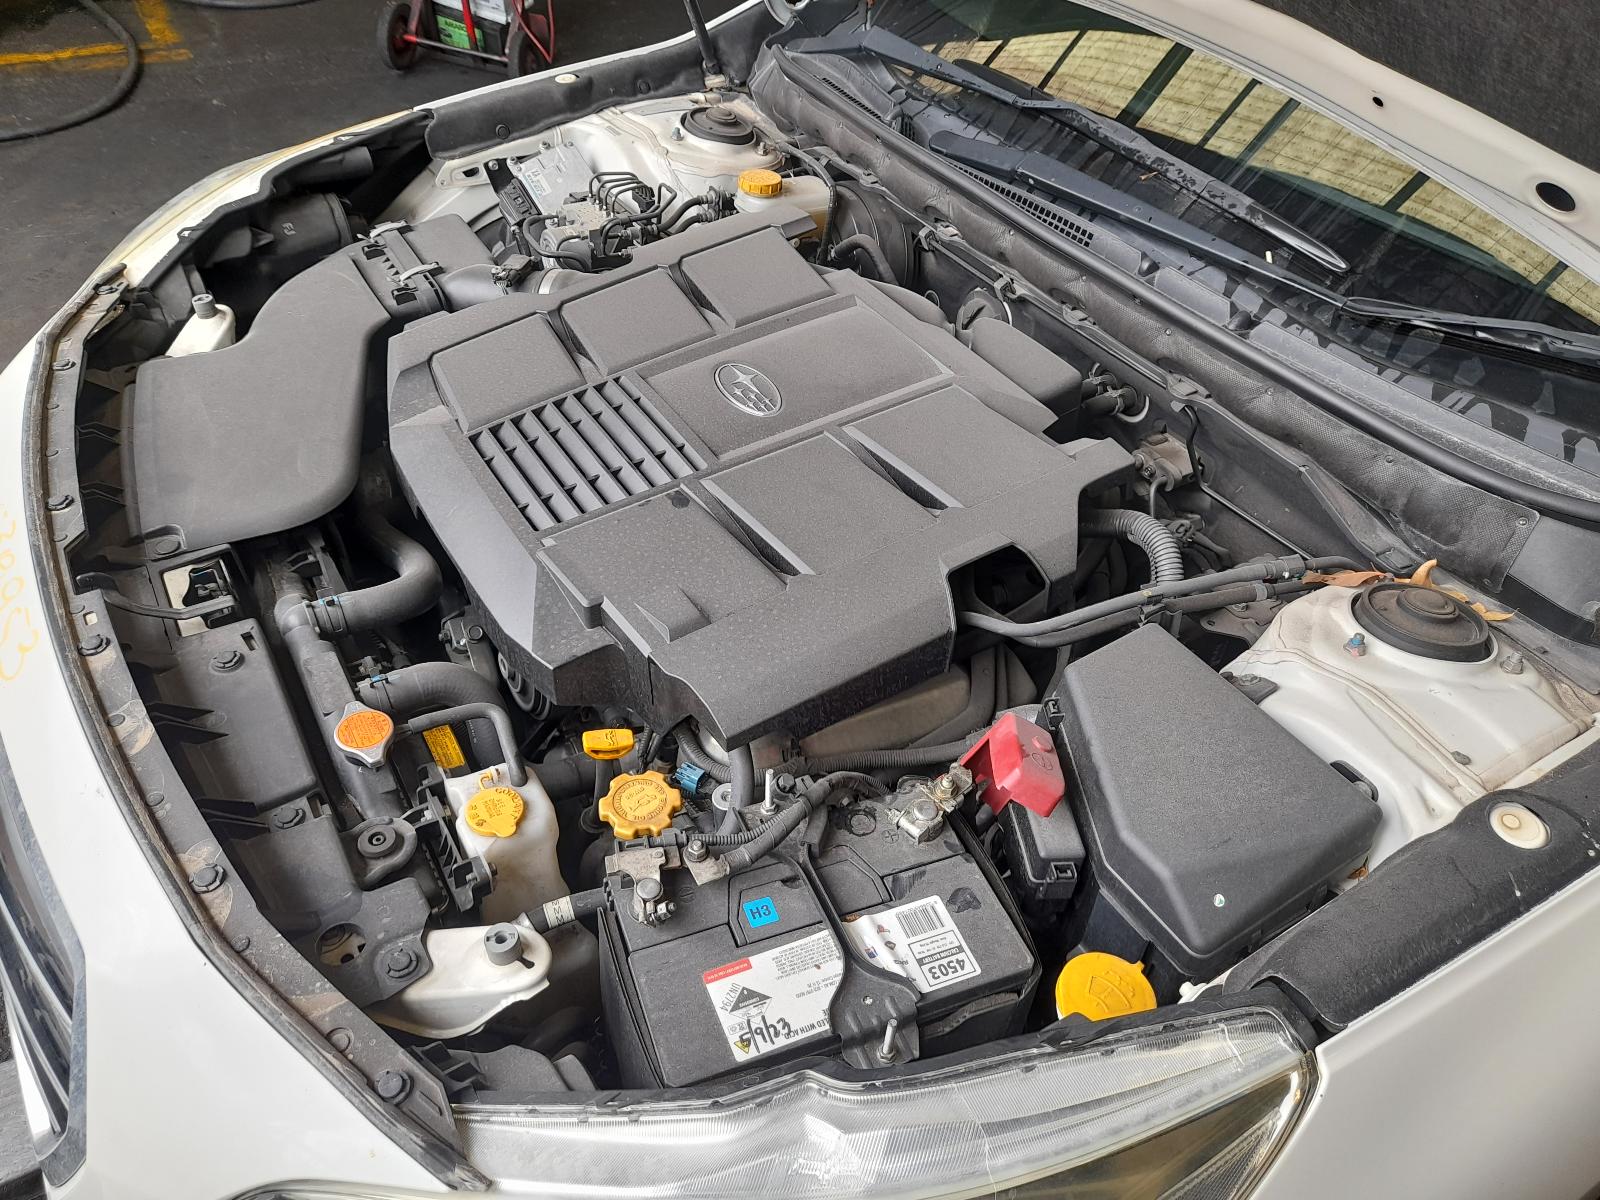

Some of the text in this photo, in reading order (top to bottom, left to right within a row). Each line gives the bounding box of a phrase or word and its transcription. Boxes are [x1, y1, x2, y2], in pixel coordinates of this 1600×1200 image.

[749, 904, 772, 920] H3
[928, 958, 966, 981] 4503
[719, 982, 741, 1012] UN2794
[799, 1022, 817, 1035] WITH
